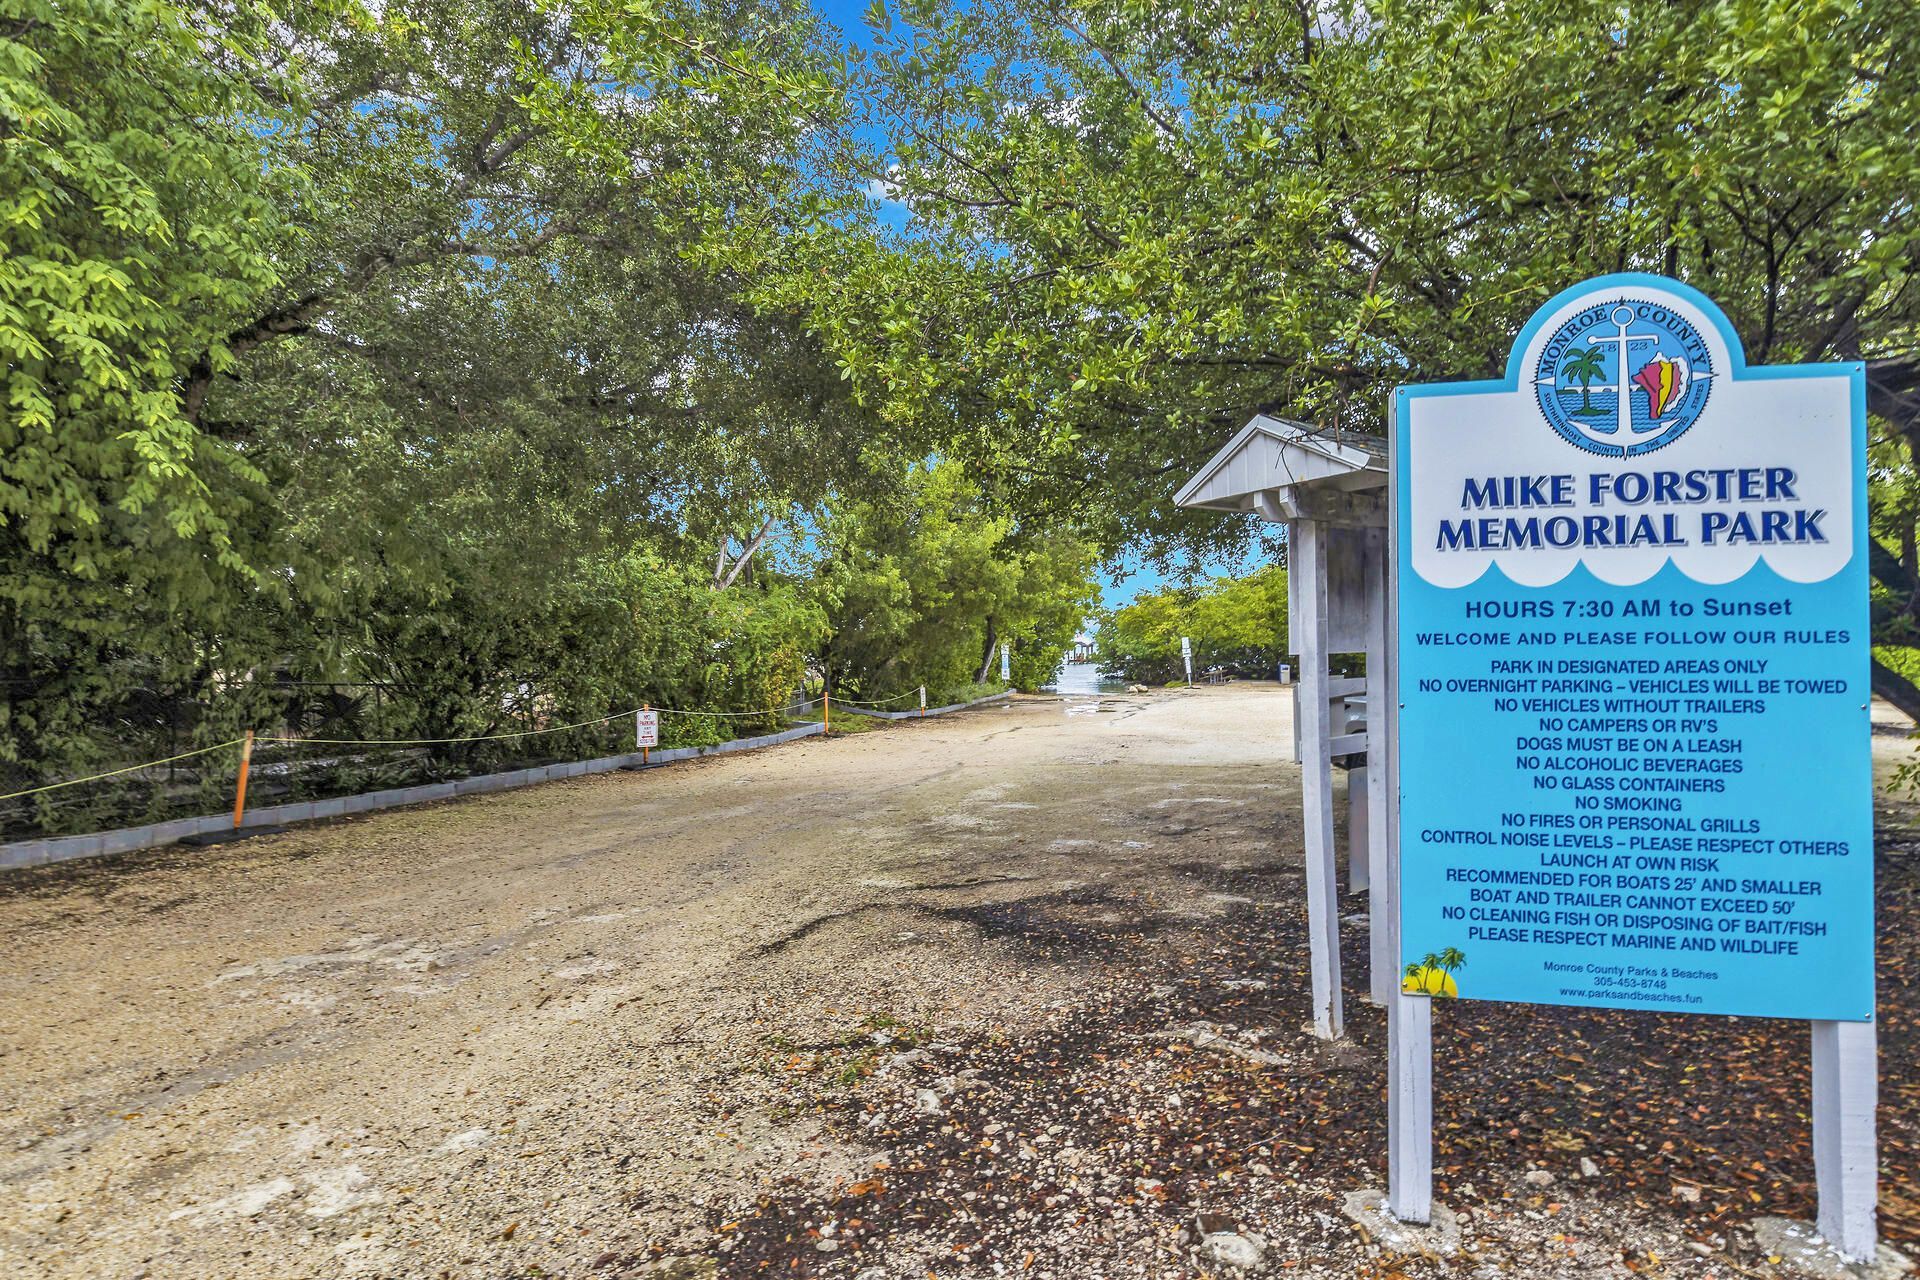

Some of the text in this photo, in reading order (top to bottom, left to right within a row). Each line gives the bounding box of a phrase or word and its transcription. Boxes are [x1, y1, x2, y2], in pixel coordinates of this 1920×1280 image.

[1541, 305, 1708, 375] MONROE COUNTY
[1601, 342, 1648, 353] 18 23
[1544, 383, 1704, 454] SOUTHERNMOST COUNTY IN THE UNITED STATES
[1460, 467, 1799, 510] MIKE FORSTER
[1436, 509, 1829, 552] MEMORIAL PARK
[1465, 597, 1793, 619] HOURS 7:30 AM to Sunset
[1415, 629, 1851, 646] WELCOME AND PLEASE FOLLOW OUR RULES
[1490, 658, 1769, 675] PARK IN DESIGNATED AREAS ONLY
[1419, 678, 1443, 693] NO
[1445, 678, 1539, 694] OVERNIGHT
[1541, 678, 1614, 694] PARKING
[1628, 678, 1710, 695] VEHICLES
[1712, 679, 1755, 694] WILL
[1757, 678, 1781, 695] BE
[1783, 679, 1848, 695] TOWED
[1494, 697, 1767, 715] NO VEHICLES WITHOUT TRAILERS
[1539, 717, 1564, 732] NO
[1567, 717, 1649, 734] CAMPERS
[1651, 718, 1677, 734] OR
[1516, 736, 1743, 754] DOGS MUST BE ON A LEASH
[1516, 755, 1744, 774] NO ALCOHOLIC BEVERAGES
[1533, 775, 1726, 794] NO GLASS CONTAINERS
[1574, 795, 1683, 813] NO SMOKING
[1501, 812, 1761, 835] NO FIRES OR PERSONAL GRILLS
[1420, 828, 1499, 846] CONTROL
[1500, 831, 1550, 848] NOISE
[1553, 833, 1614, 850] LEVELS
[1629, 835, 1694, 852] PLEASE
[1696, 837, 1776, 855] RESPECT
[1778, 839, 1850, 857] OTHERS
[1540, 852, 1720, 873] LAUNCH AT OWN RISK
[1445, 867, 1575, 887] RECOMMENDED
[1578, 872, 1613, 889] FOR
[1615, 874, 1672, 892] BOATS
[1700, 877, 1738, 894] AND
[1740, 878, 1822, 896] SMALLER
[1469, 887, 1513, 904] BOAT
[1514, 889, 1551, 905] AND
[1552, 891, 1623, 909] TRAILER
[1625, 894, 1697, 912] CANNOT
[1700, 897, 1770, 915] EXCEED
[1441, 905, 1827, 937] NO CLEANING FISH OR DISPOSING OF BAIT/FISH
[1468, 925, 1800, 956] PLEASE RESPECT MARINE AND WILDLIFE
[1543, 960, 1719, 981] Monroe County Parks & Beaches
[1594, 977, 1668, 990] 305-453-8748
[1559, 988, 1703, 1004] www.parksandbeaches.fun
